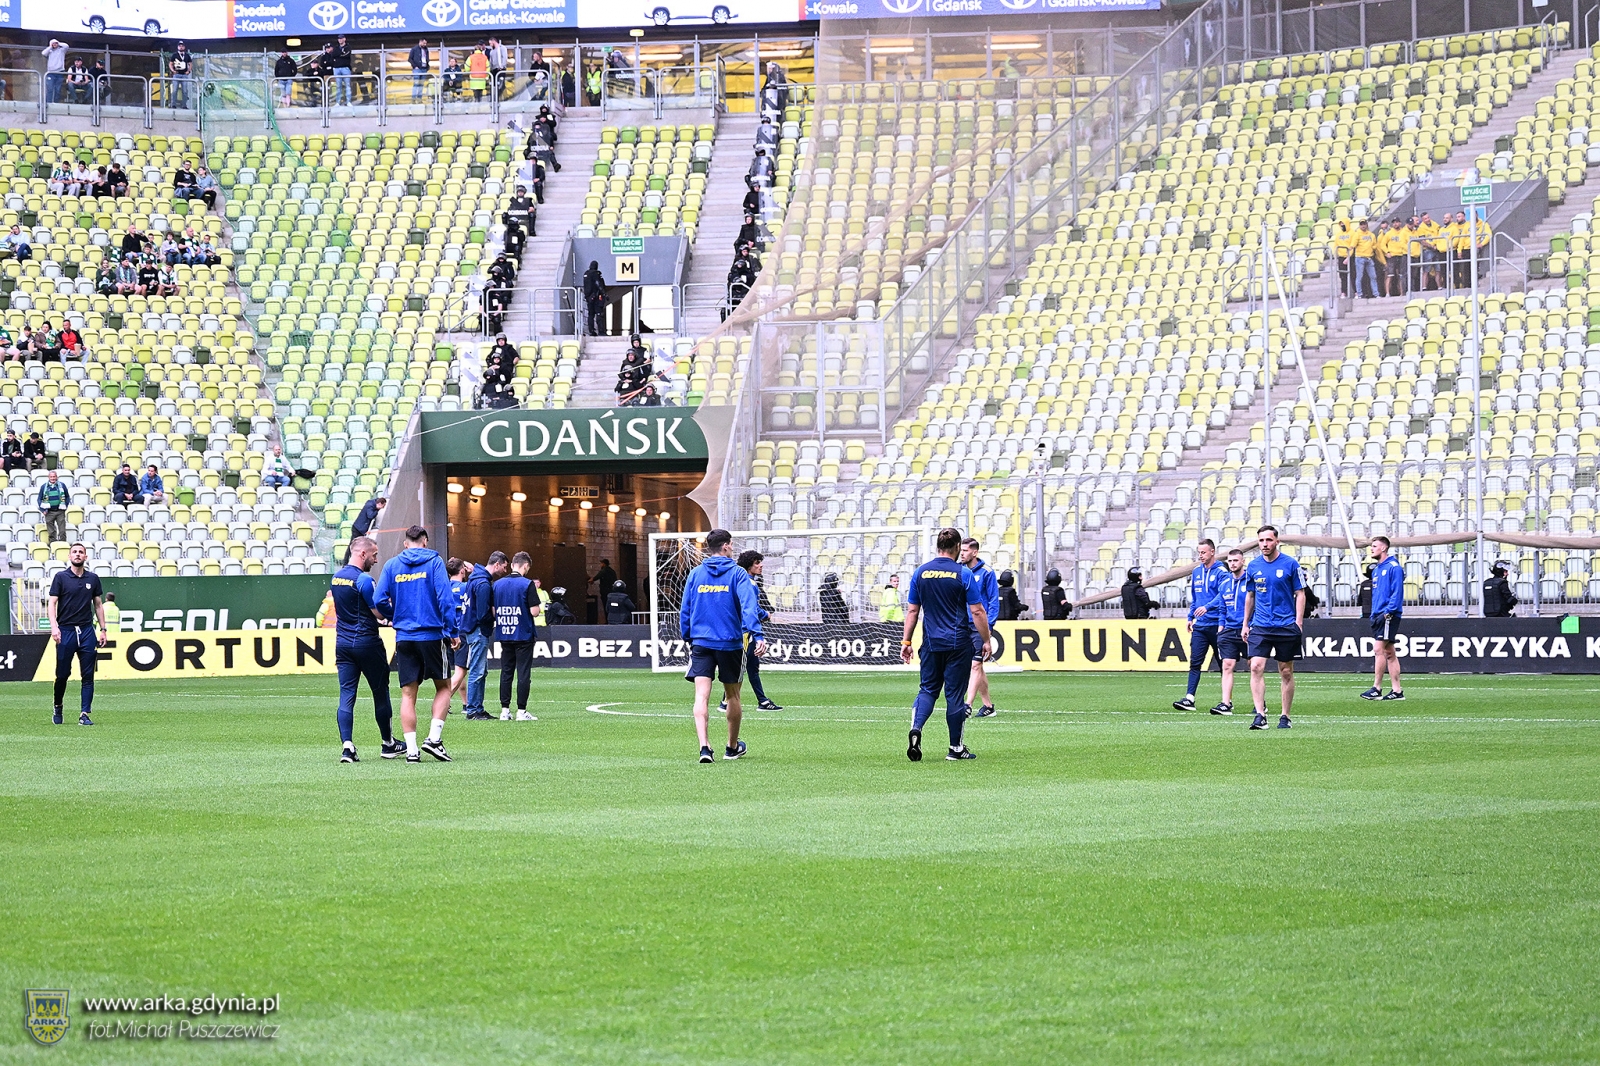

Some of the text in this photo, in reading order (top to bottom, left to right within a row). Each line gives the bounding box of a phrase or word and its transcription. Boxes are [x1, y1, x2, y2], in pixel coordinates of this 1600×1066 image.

[356, 1, 398, 14] Carter
[357, 15, 406, 29] Gdańsk
[469, 11, 566, 25] Gdańsk-Kowale
[1463, 187, 1490, 195] WYJŚCIE
[613, 238, 642, 246] WYJŚCIE
[621, 262, 634, 274] M
[480, 410, 688, 458] GDAŃSK
[394, 572, 427, 583] GDYNIA
[921, 570, 958, 580] GDYNIA
[331, 577, 354, 589] GDYNIA
[697, 585, 730, 594] GDYNIA
[497, 616, 519, 626] KLUB
[501, 626, 517, 635] 017
[578, 637, 633, 658] BEZ
[799, 638, 823, 657] do
[829, 639, 866, 657] 100
[871, 638, 892, 657] zł
[990, 628, 1189, 662] RTUNA
[1452, 637, 1572, 659] RYZYKA
[95, 635, 324, 672] FORTUN
